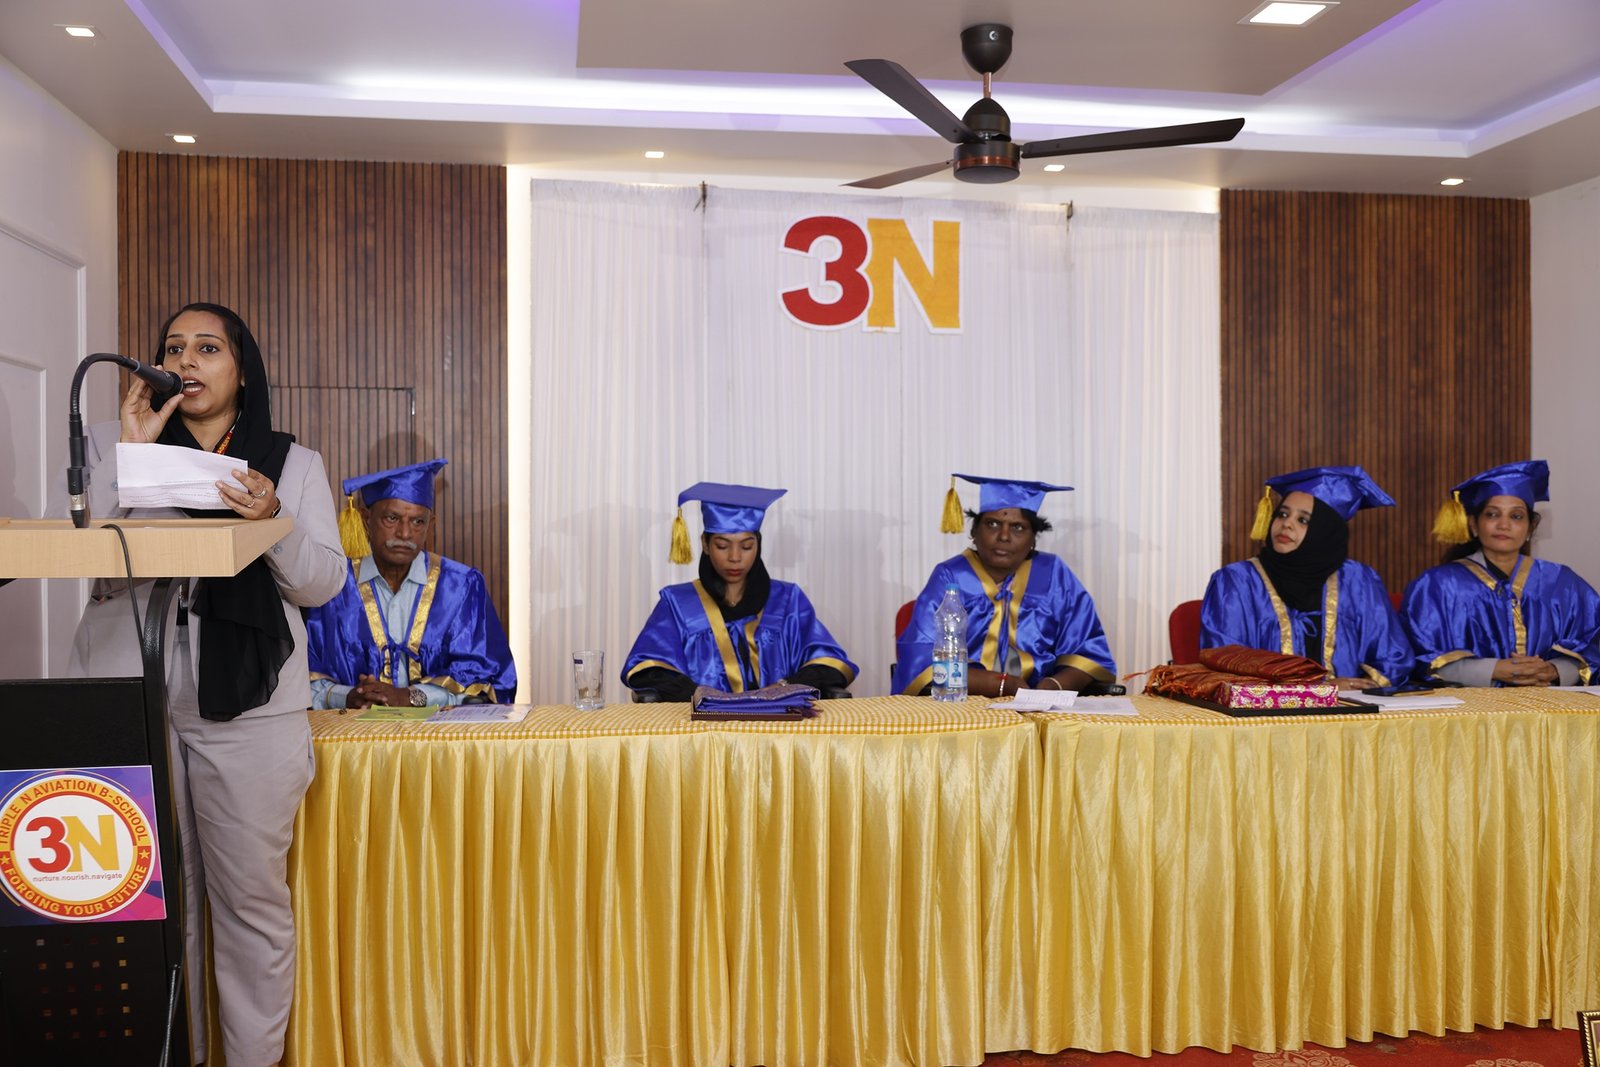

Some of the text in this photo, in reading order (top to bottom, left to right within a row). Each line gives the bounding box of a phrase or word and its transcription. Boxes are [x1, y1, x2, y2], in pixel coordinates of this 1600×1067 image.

[781, 215, 961, 329] 3N
[20, 794, 33, 804] N
[33, 779, 97, 798] AVIATION
[99, 787, 148, 841] B-SCHOOL
[26, 814, 120, 873] 3N
[5, 865, 147, 915] FORGING YOUR FUTURE
